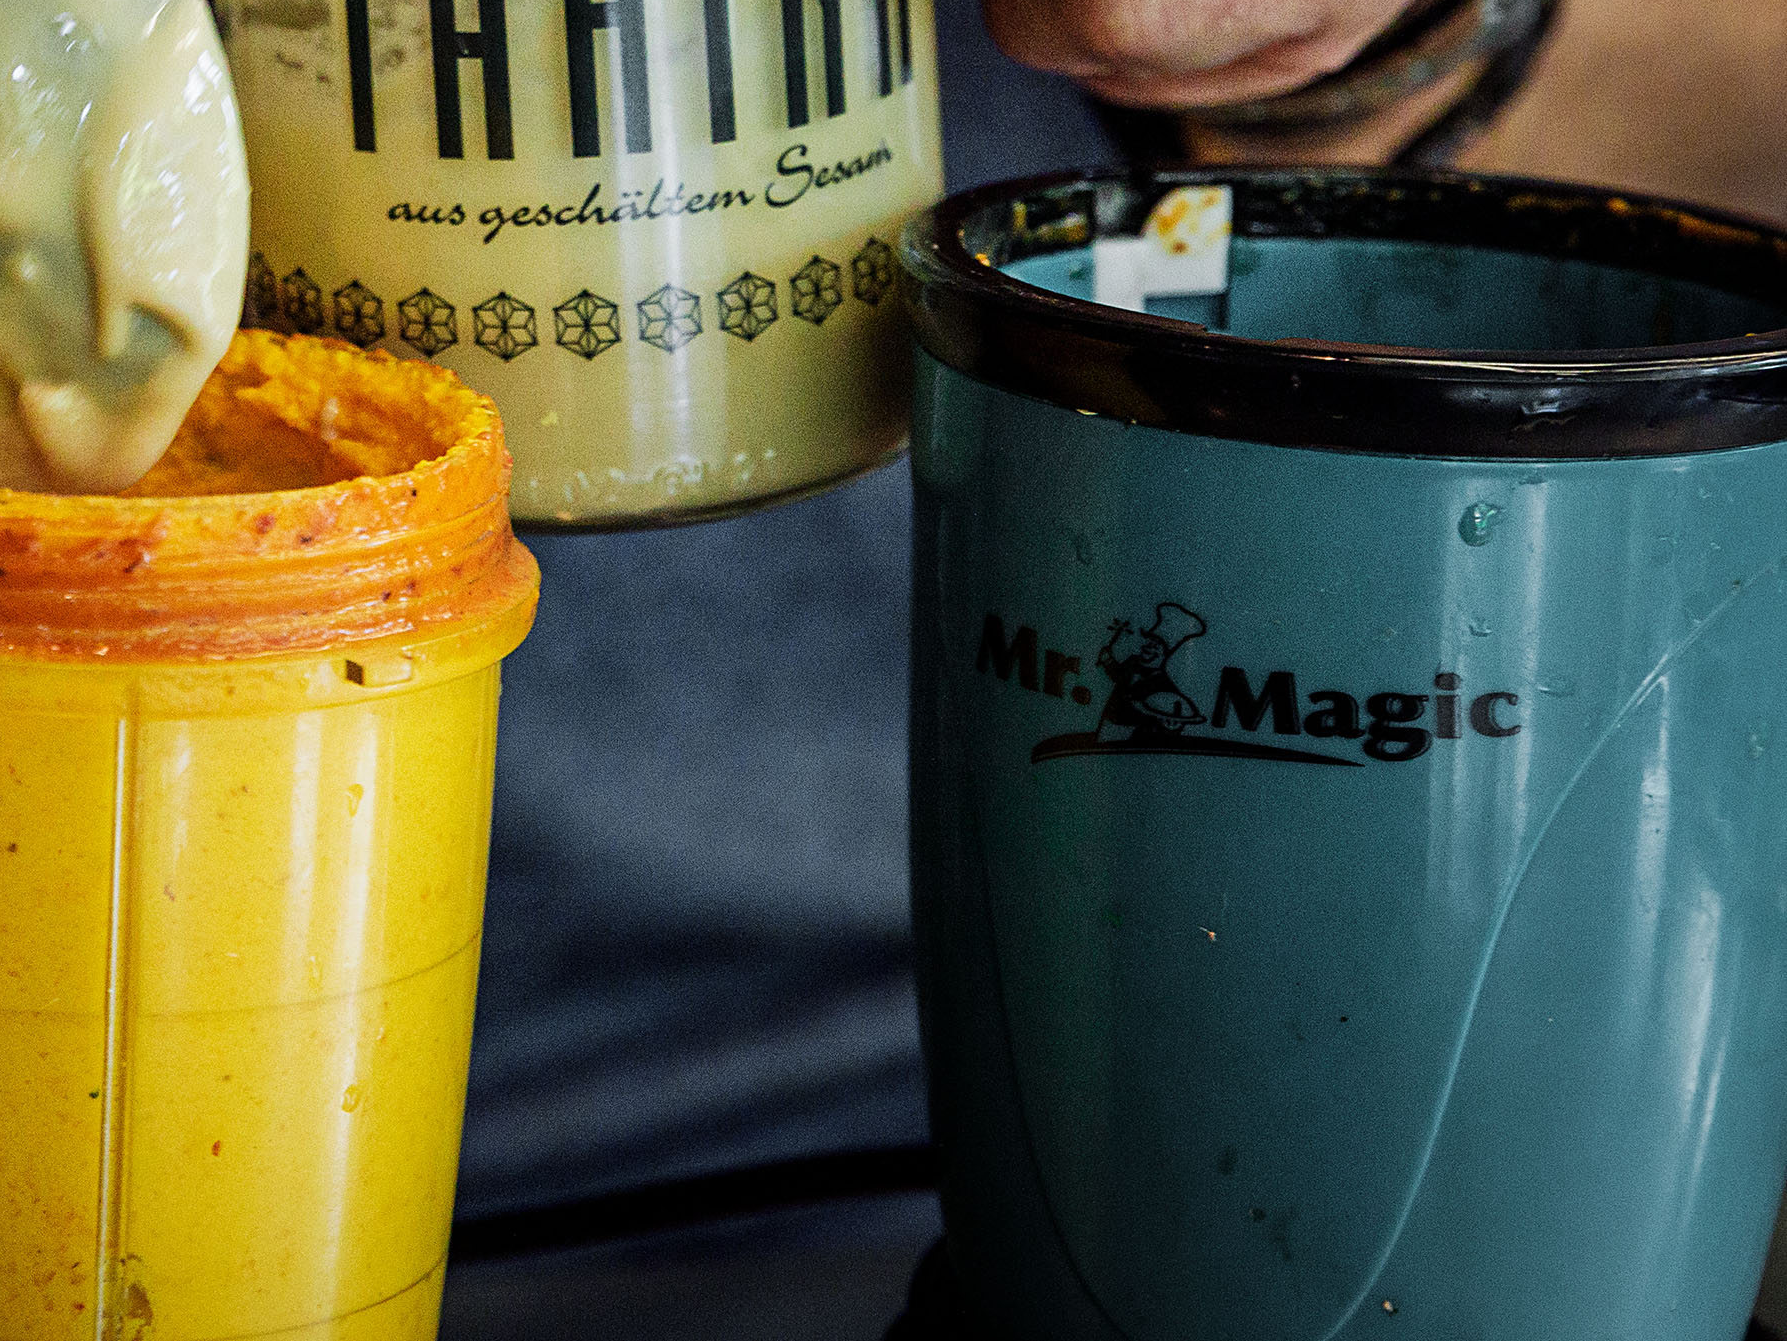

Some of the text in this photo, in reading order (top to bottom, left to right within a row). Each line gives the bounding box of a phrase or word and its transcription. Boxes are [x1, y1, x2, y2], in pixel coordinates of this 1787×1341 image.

[387, 139, 895, 245] aus geschältem Sesam
[975, 613, 1521, 762] Mr. Magic
